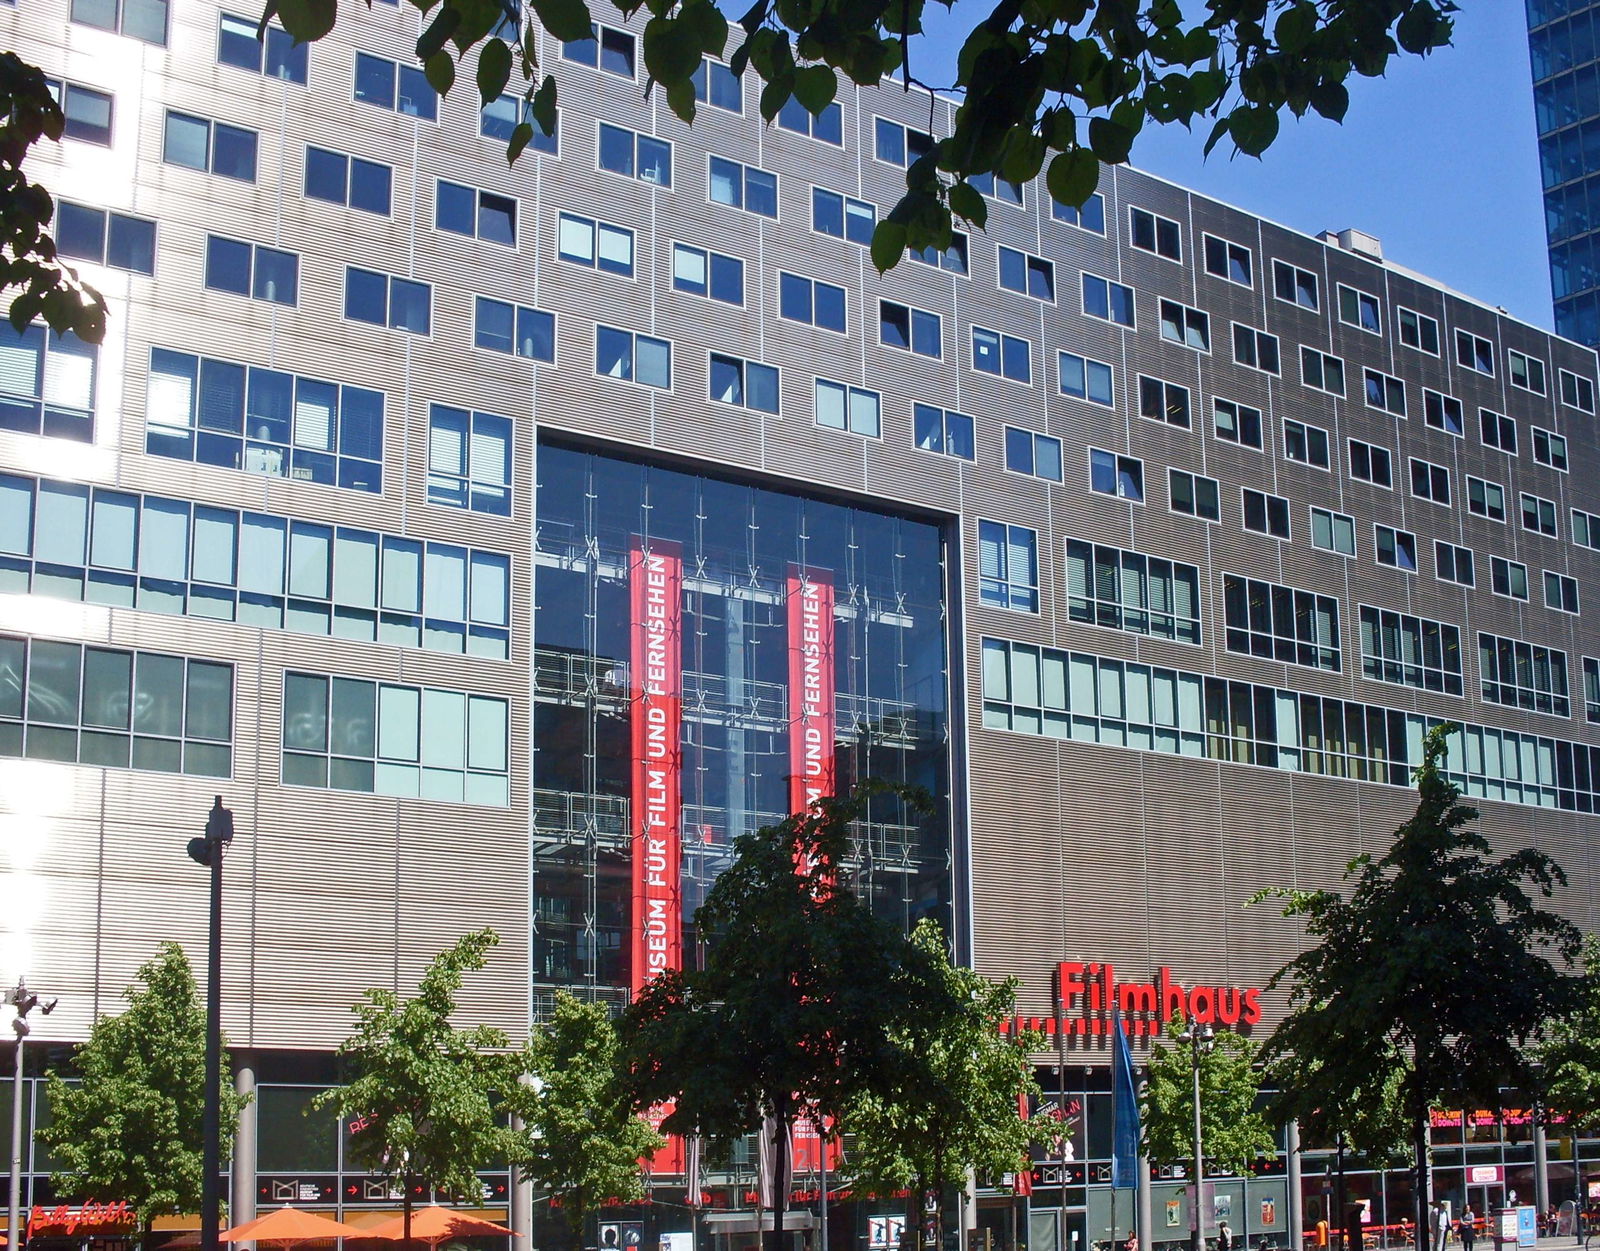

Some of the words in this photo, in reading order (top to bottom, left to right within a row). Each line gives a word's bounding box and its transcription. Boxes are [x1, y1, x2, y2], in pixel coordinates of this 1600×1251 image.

[647, 555, 666, 696] FERNSEHEN
[803, 584, 820, 717] FERNSEHEN
[647, 707, 666, 759] UND
[805, 728, 821, 776] UND
[647, 771, 667, 827] FILM
[644, 839, 667, 886] FÜR
[647, 899, 667, 984] USEUM
[1059, 962, 1262, 1025] Filmhaus
[28, 1205, 80, 1240] Billy
